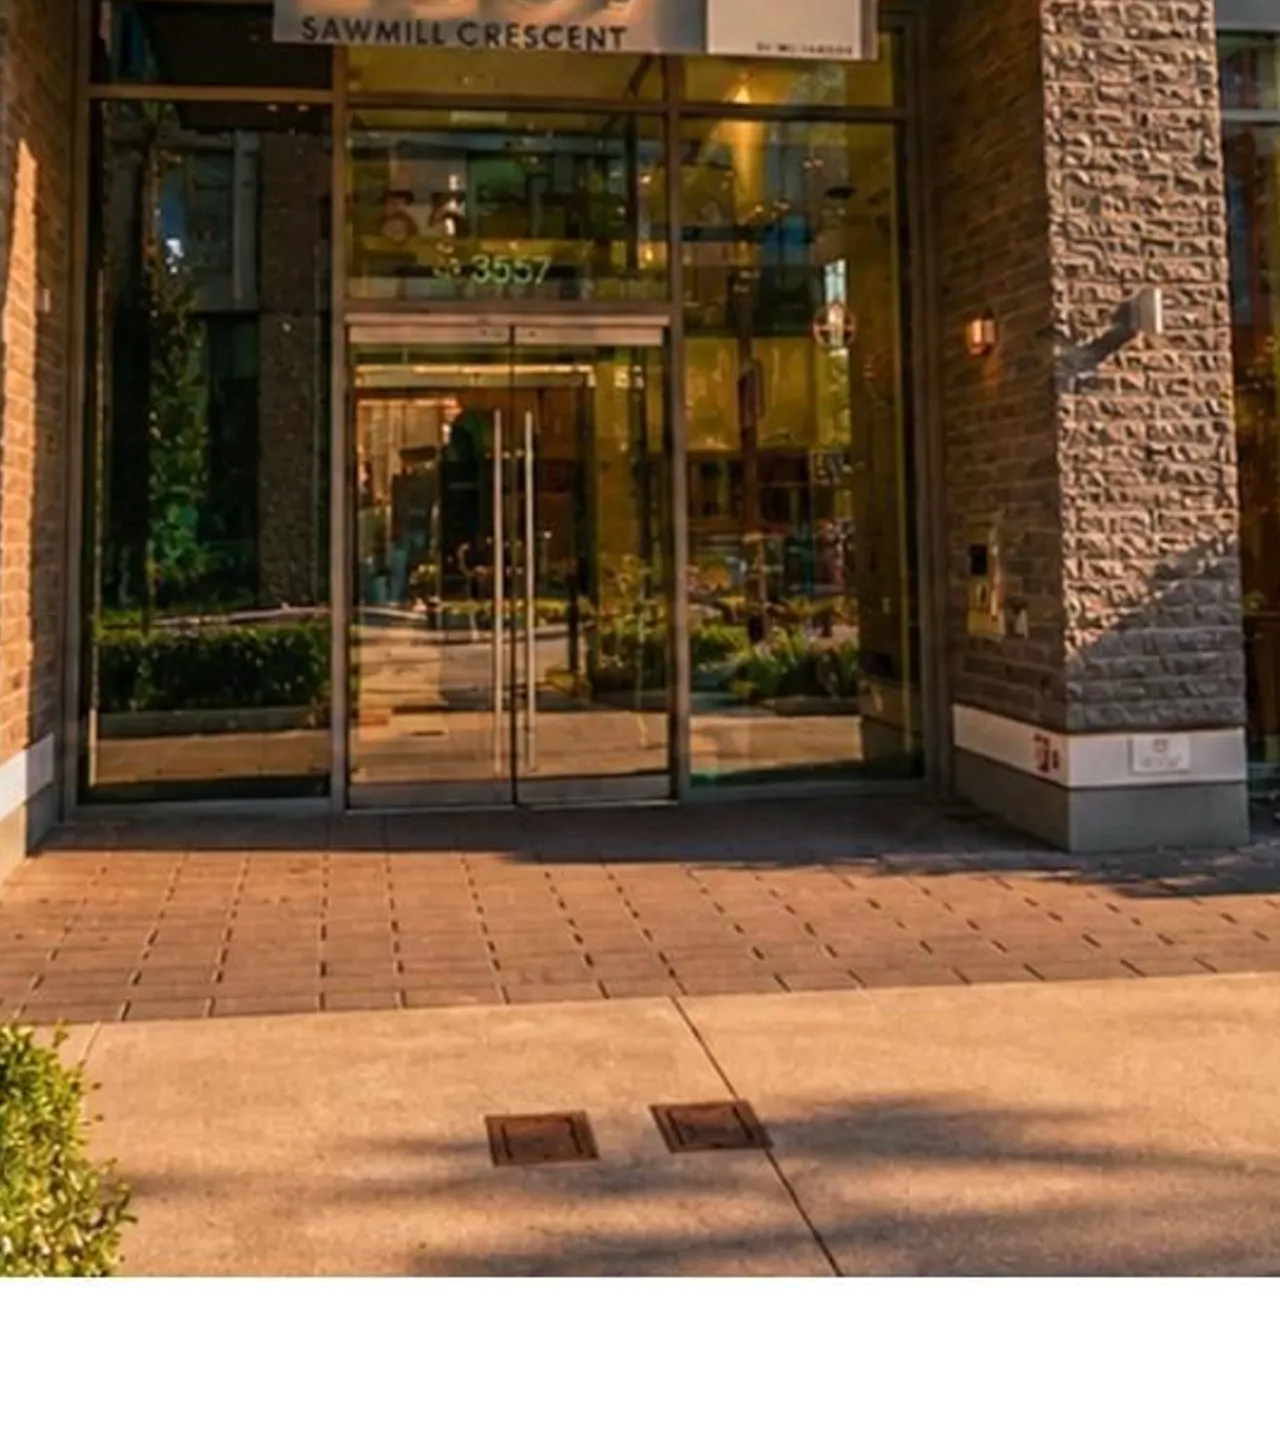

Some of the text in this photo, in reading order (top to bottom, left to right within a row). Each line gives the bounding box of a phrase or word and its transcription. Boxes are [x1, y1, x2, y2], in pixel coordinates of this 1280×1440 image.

[300, 16, 628, 51] SAWMILL CRESCENT
[469, 252, 552, 285] 3557
